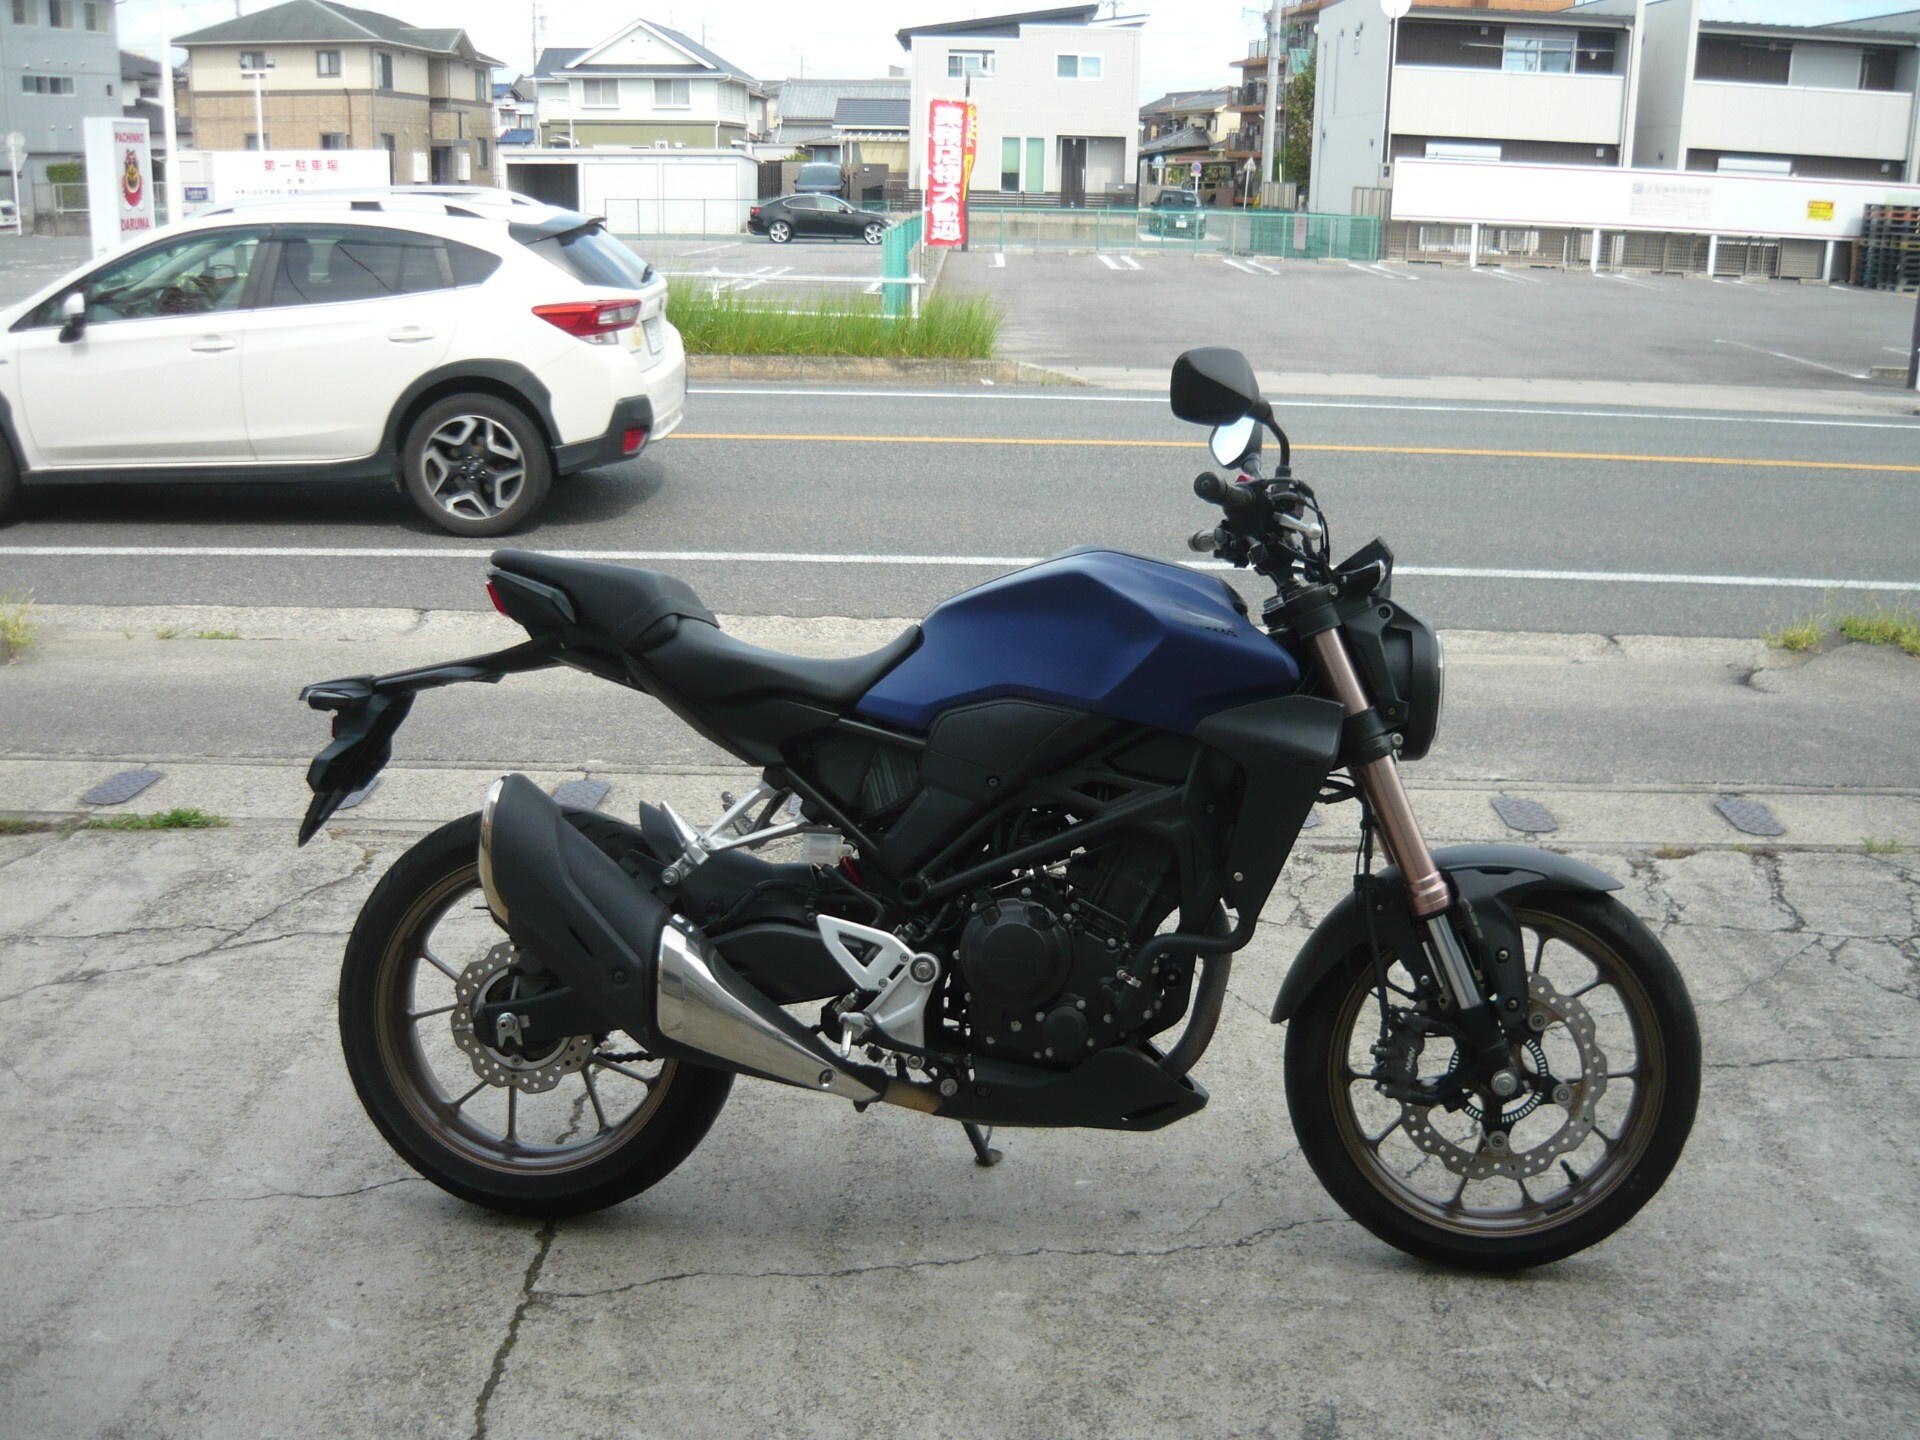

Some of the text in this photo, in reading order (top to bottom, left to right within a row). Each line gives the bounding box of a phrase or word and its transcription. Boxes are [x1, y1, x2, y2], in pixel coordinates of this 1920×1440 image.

[114, 132, 145, 143] PACHINKO
[264, 160, 339, 172] 第一駐車場
[121, 217, 150, 232] DARUMA
